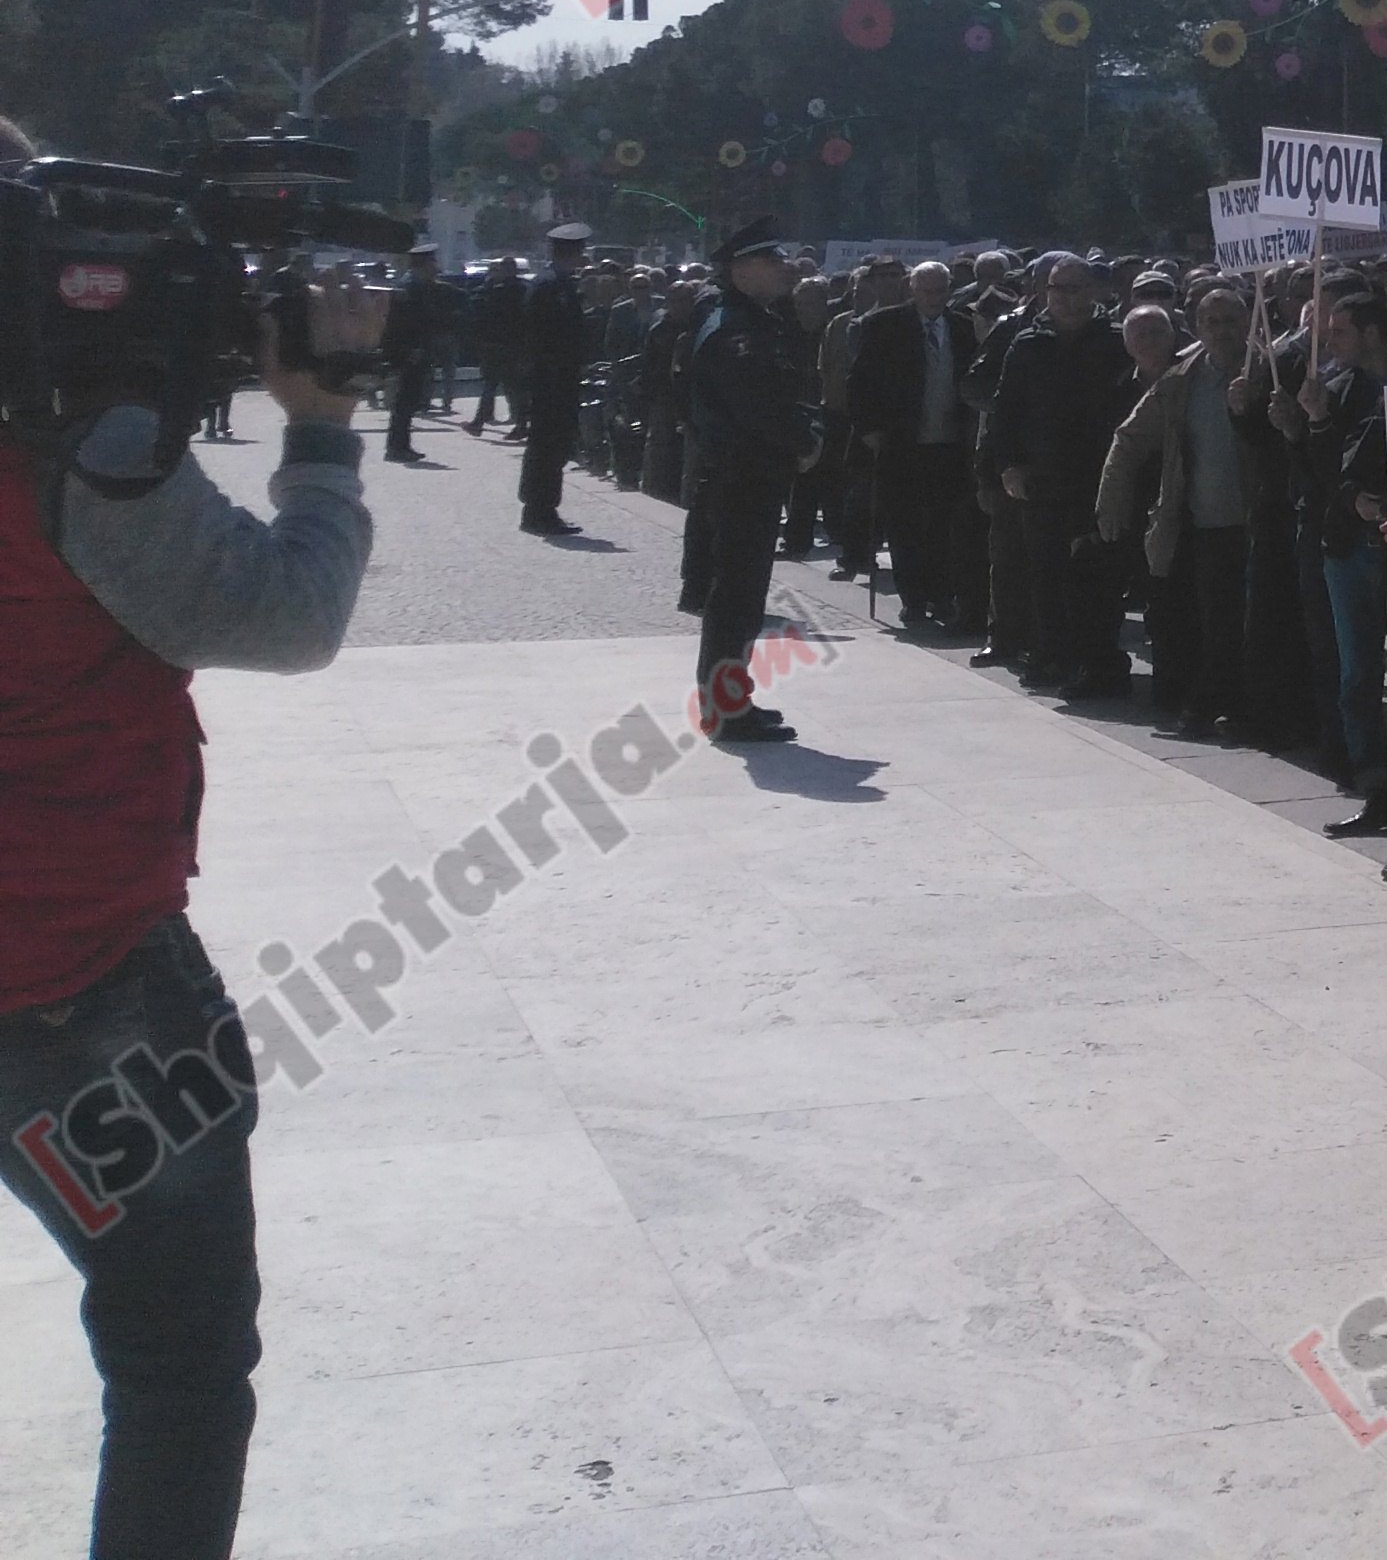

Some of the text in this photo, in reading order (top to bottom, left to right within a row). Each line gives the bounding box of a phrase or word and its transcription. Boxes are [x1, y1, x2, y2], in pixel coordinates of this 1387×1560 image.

[1264, 140, 1379, 217] KUÇOVA
[1219, 191, 1235, 218] PA
[1217, 240, 1243, 269] NUK
[1243, 237, 1260, 266] KA
